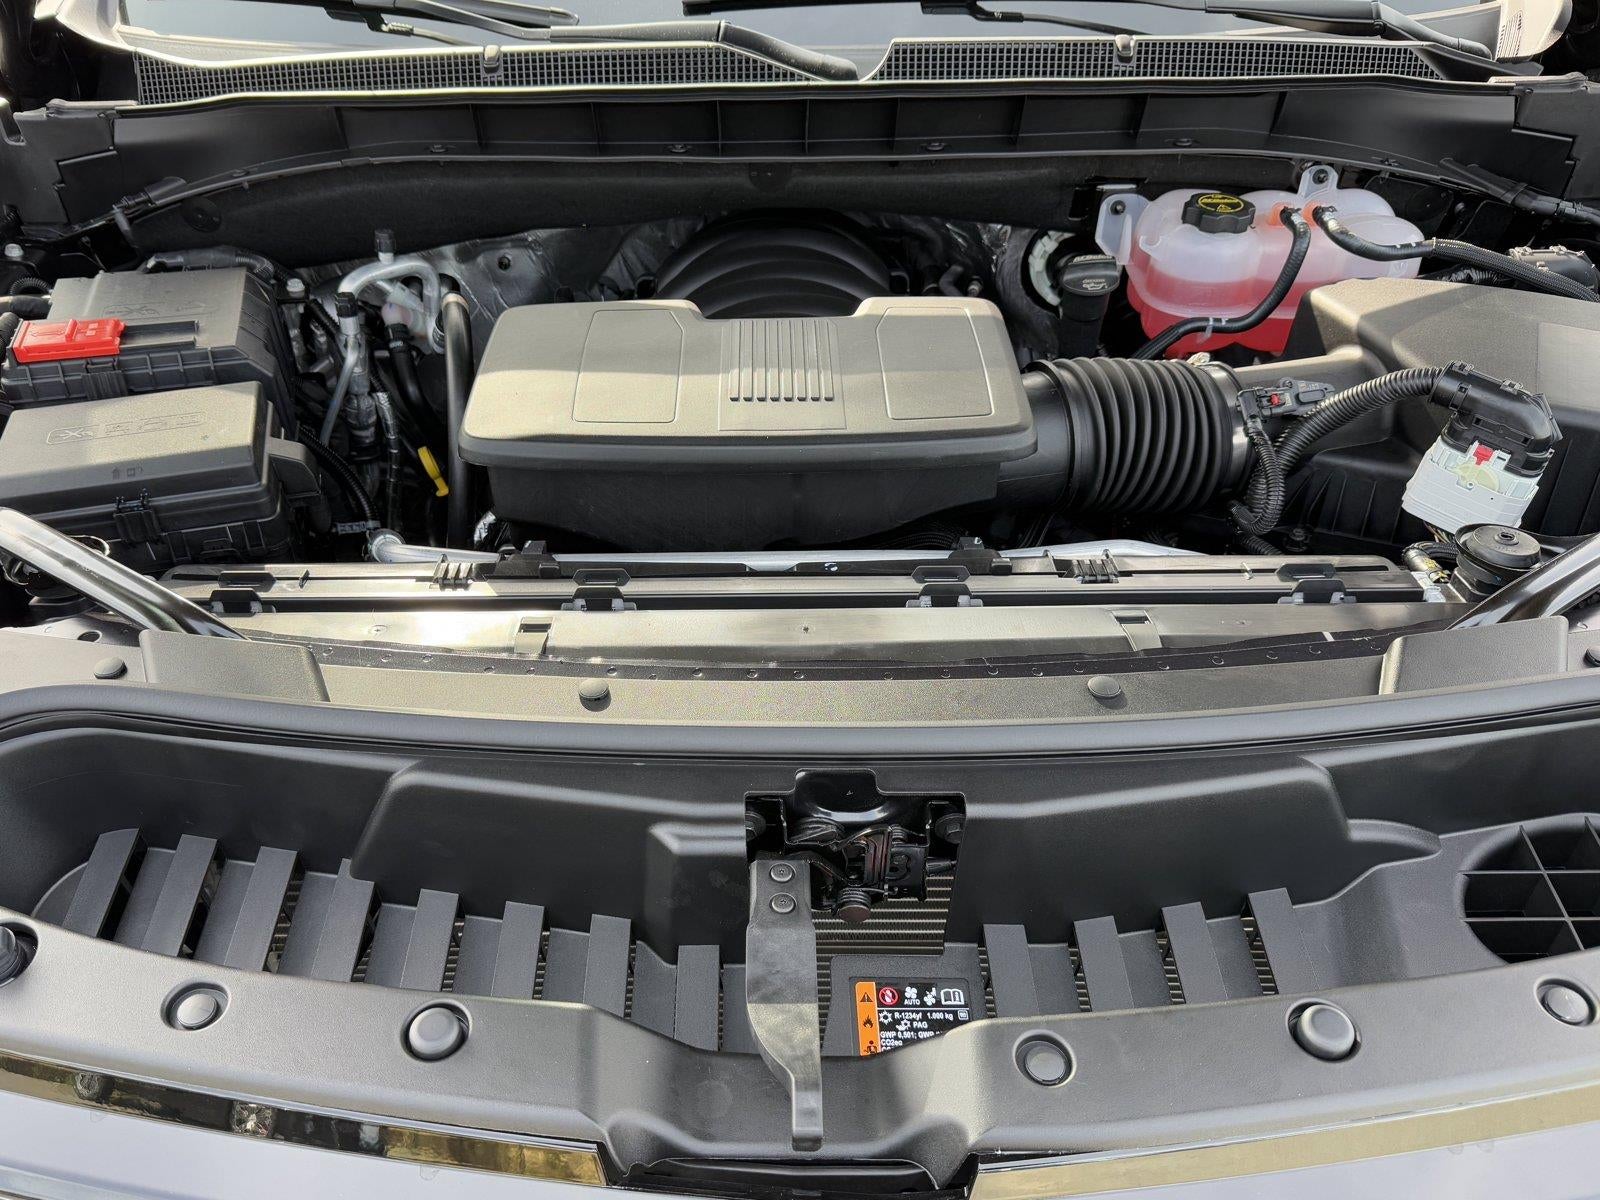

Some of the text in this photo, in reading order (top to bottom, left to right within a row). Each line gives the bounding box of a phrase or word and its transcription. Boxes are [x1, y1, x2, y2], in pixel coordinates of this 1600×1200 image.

[945, 1012, 953, 1021] kg
[913, 1021, 928, 1029] PAG
[880, 1031, 896, 1039] GWP
